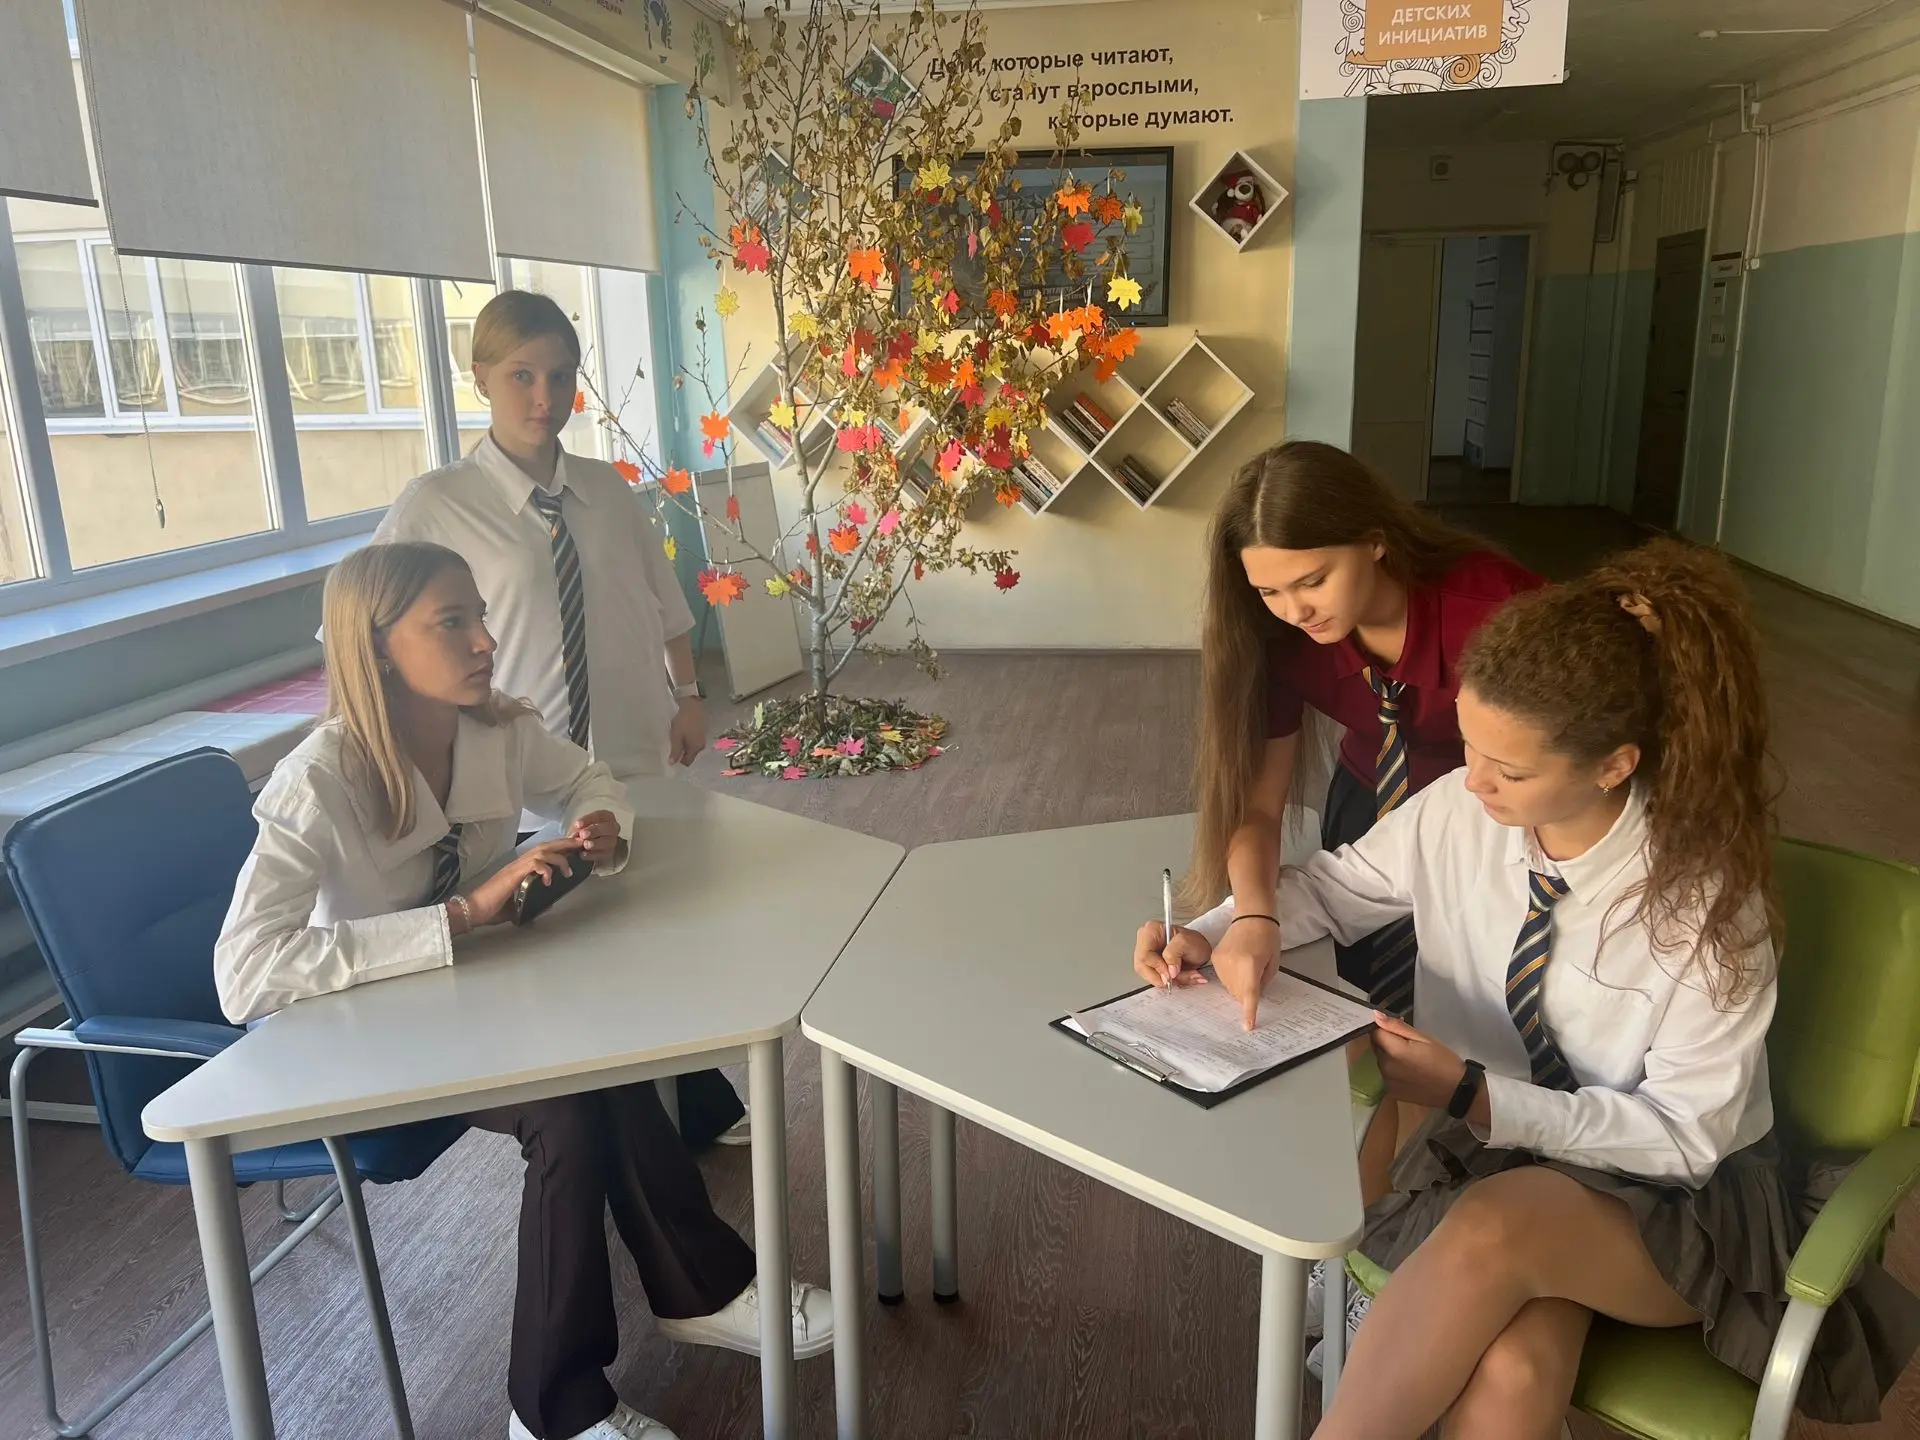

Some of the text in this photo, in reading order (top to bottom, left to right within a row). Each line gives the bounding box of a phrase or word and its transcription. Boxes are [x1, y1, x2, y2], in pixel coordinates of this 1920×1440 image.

[1391, 4, 1472, 26] ДЕТСКИХ
[1378, 24, 1488, 46] ИНИЦИАТИВ
[992, 52, 1084, 76] которые
[1090, 46, 1175, 66] читают,
[1144, 105, 1235, 129] думают.
